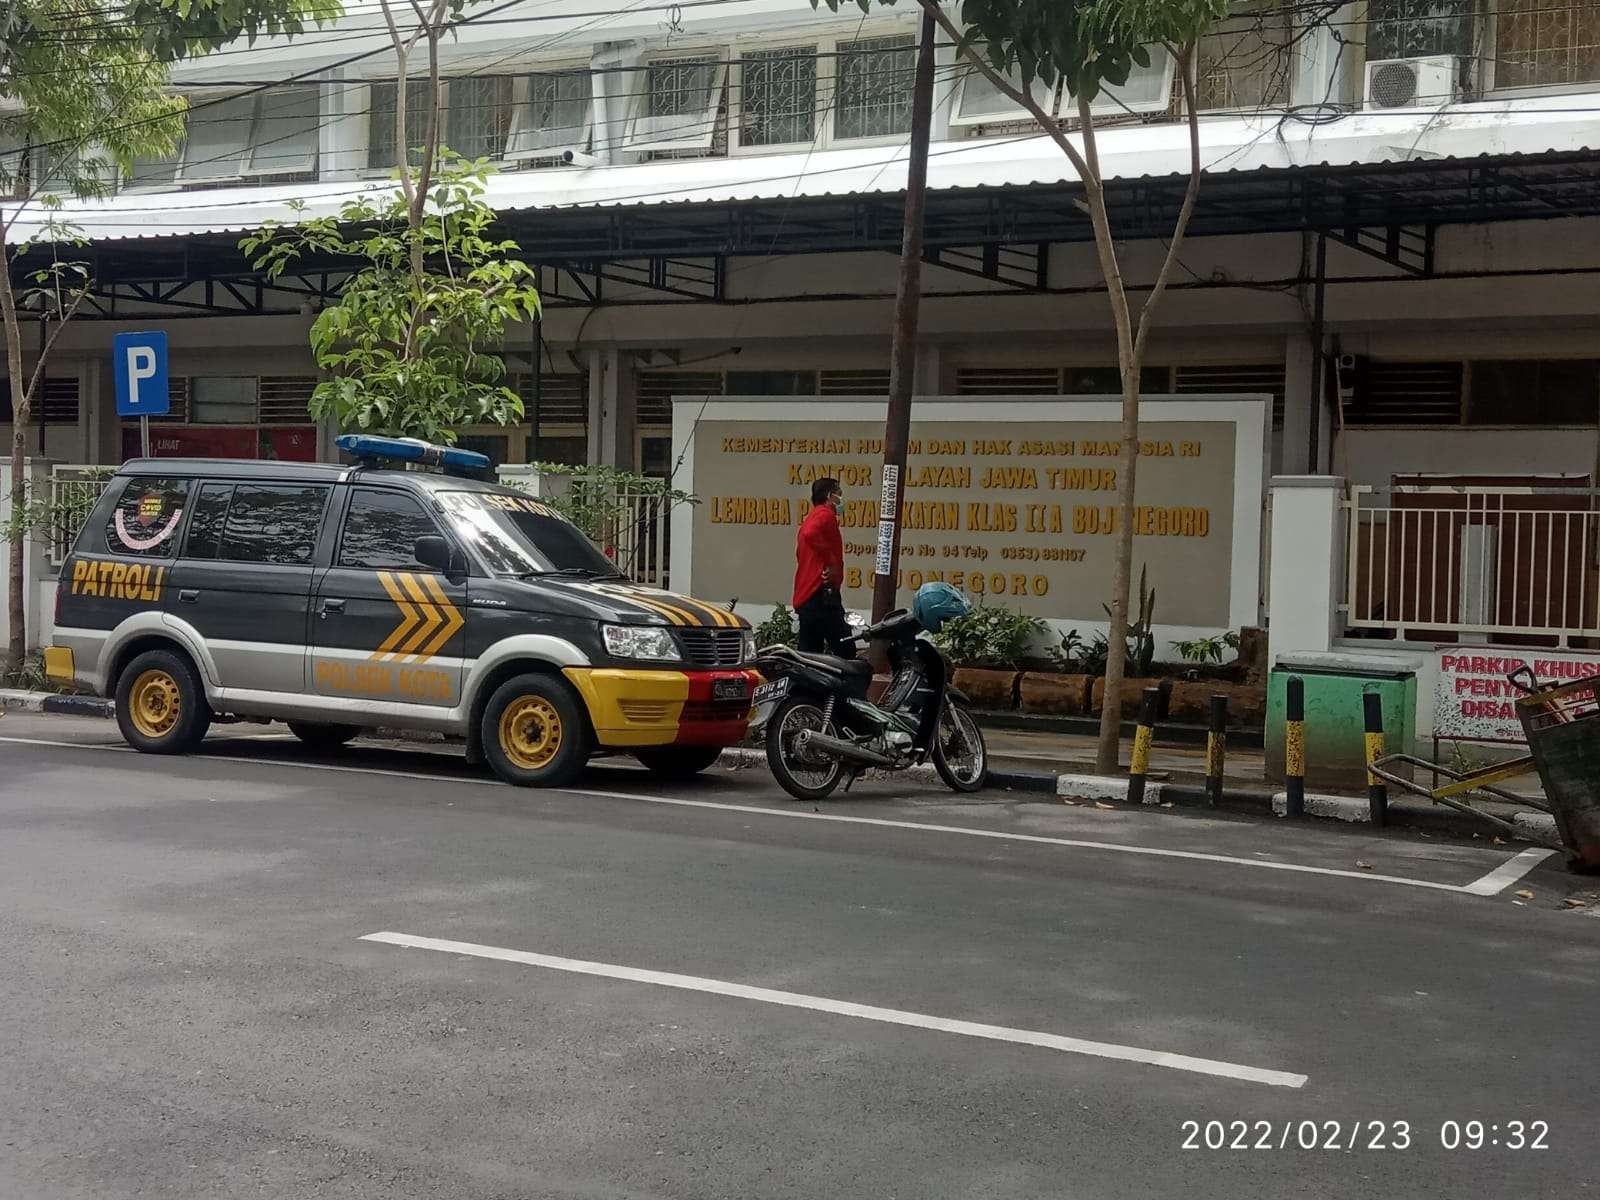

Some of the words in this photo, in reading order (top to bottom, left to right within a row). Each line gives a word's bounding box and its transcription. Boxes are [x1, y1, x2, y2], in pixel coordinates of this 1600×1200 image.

[127, 345, 157, 403] P
[722, 438, 850, 454] KEMENTERIAN
[857, 439, 921, 455] HUM
[928, 440, 966, 456] DAN
[972, 440, 1013, 456] HAK
[1019, 440, 1075, 456] ASASI
[1080, 440, 1174, 457] MANSIA
[1180, 441, 1201, 457] RI
[788, 463, 872, 487] KANTOR
[979, 466, 1038, 489] JAWA
[1046, 467, 1117, 491] TIMUR
[710, 496, 790, 525] LEMBAGA
[967, 502, 1017, 532] KLAS
[918, 543, 935, 557] No
[961, 544, 988, 561] Telp
[71, 560, 164, 601] PATROLI
[1534, 660, 1600, 679] KHUS
